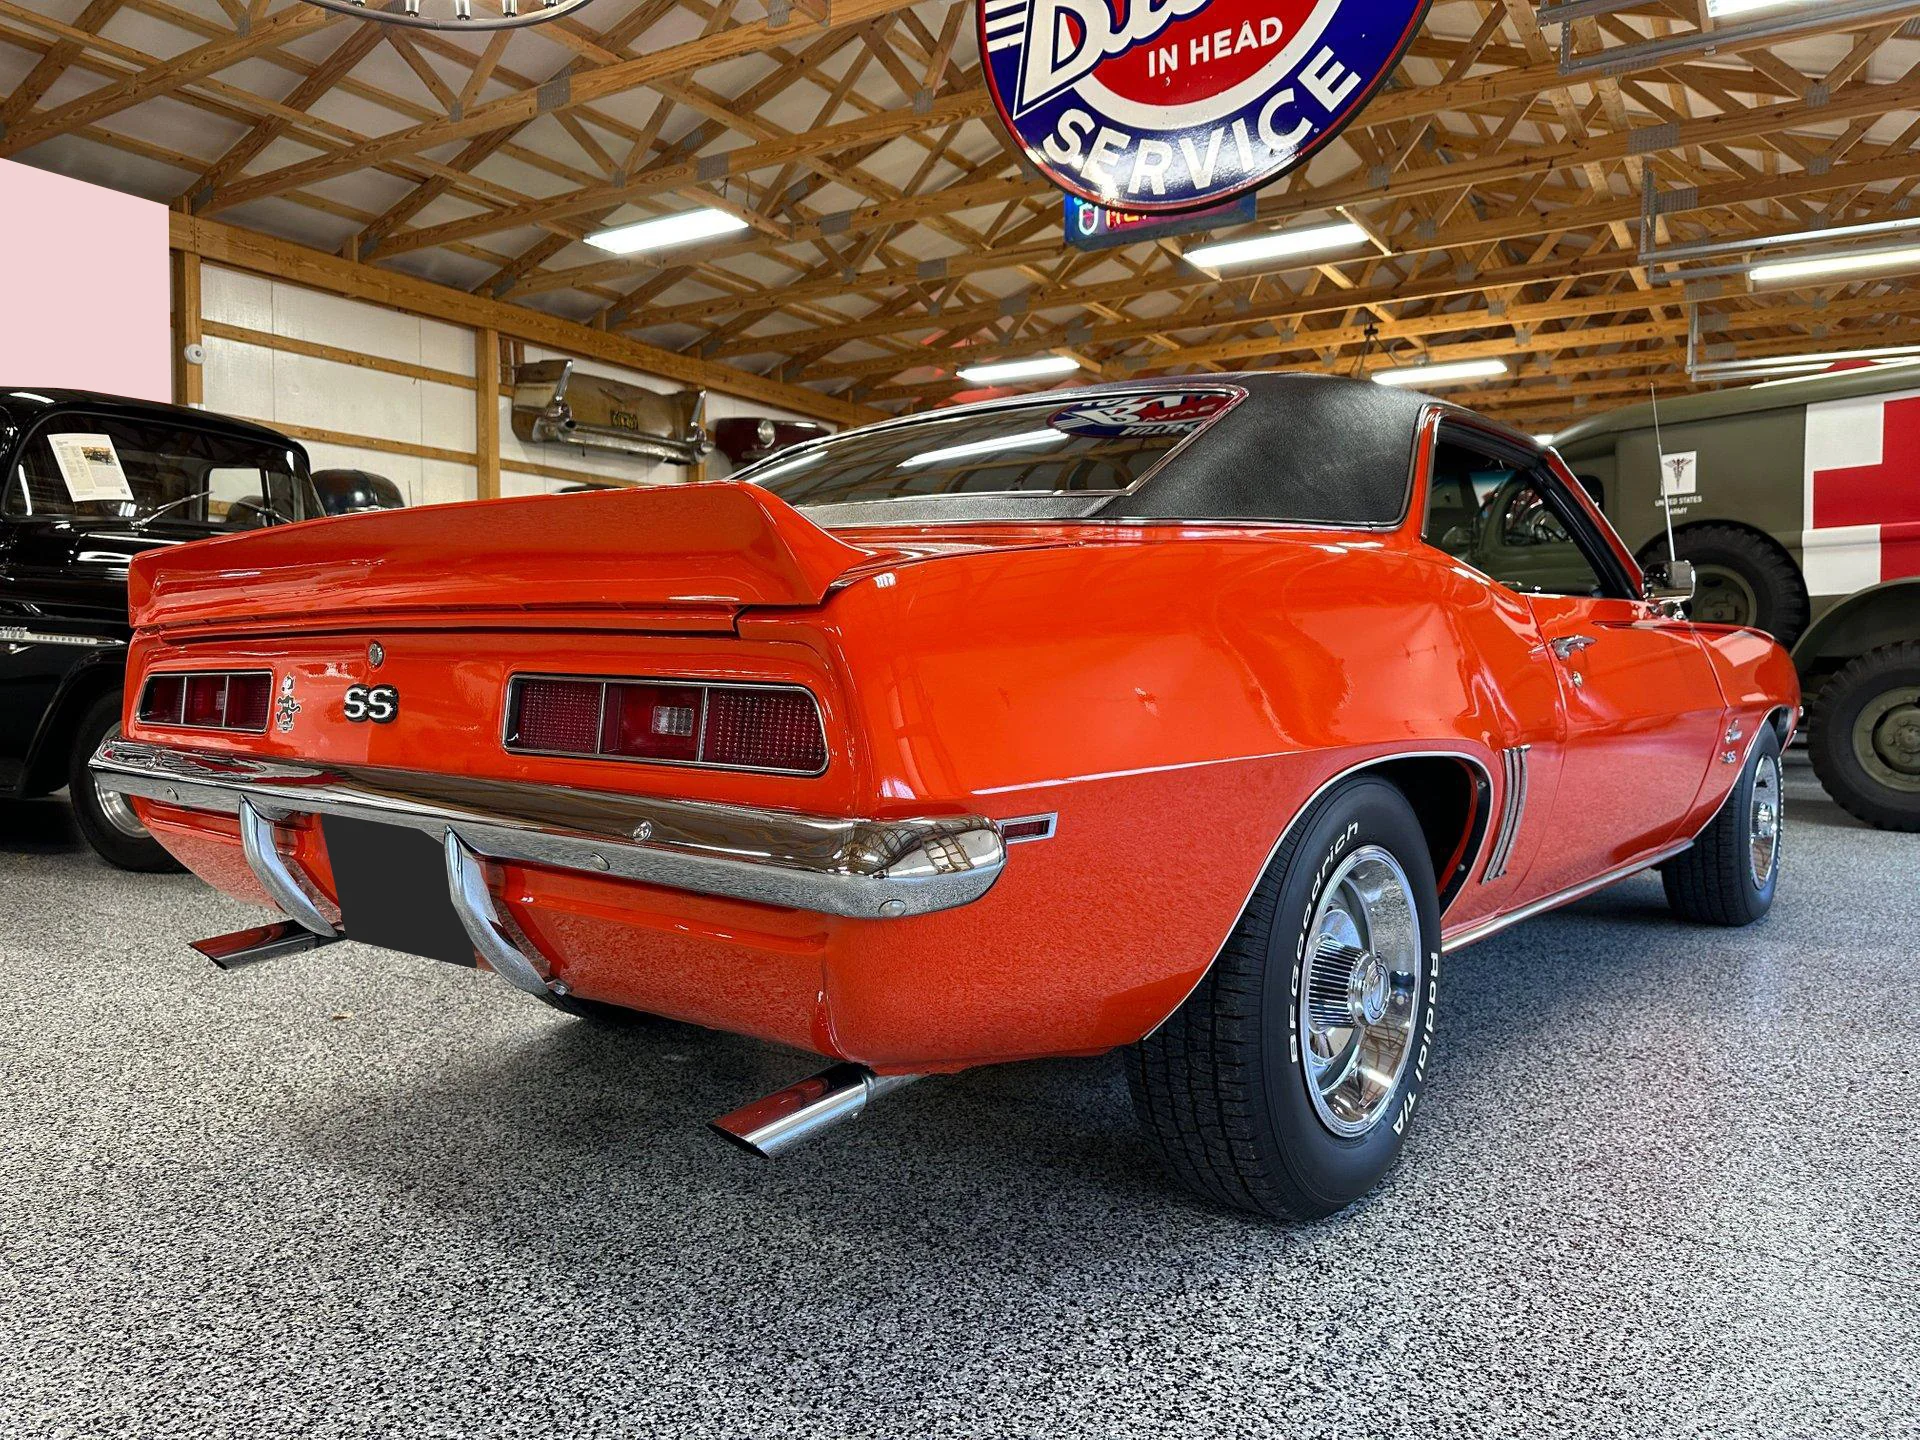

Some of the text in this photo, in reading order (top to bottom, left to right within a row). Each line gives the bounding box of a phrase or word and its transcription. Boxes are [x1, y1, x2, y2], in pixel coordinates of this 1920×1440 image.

[1042, 47, 1362, 196] SERVICE
[1148, 16, 1284, 78] IN HEAD
[343, 686, 397, 721] SS
[1289, 820, 1359, 1063] BFGoodrich
[1392, 952, 1439, 1136] Radial T/A
